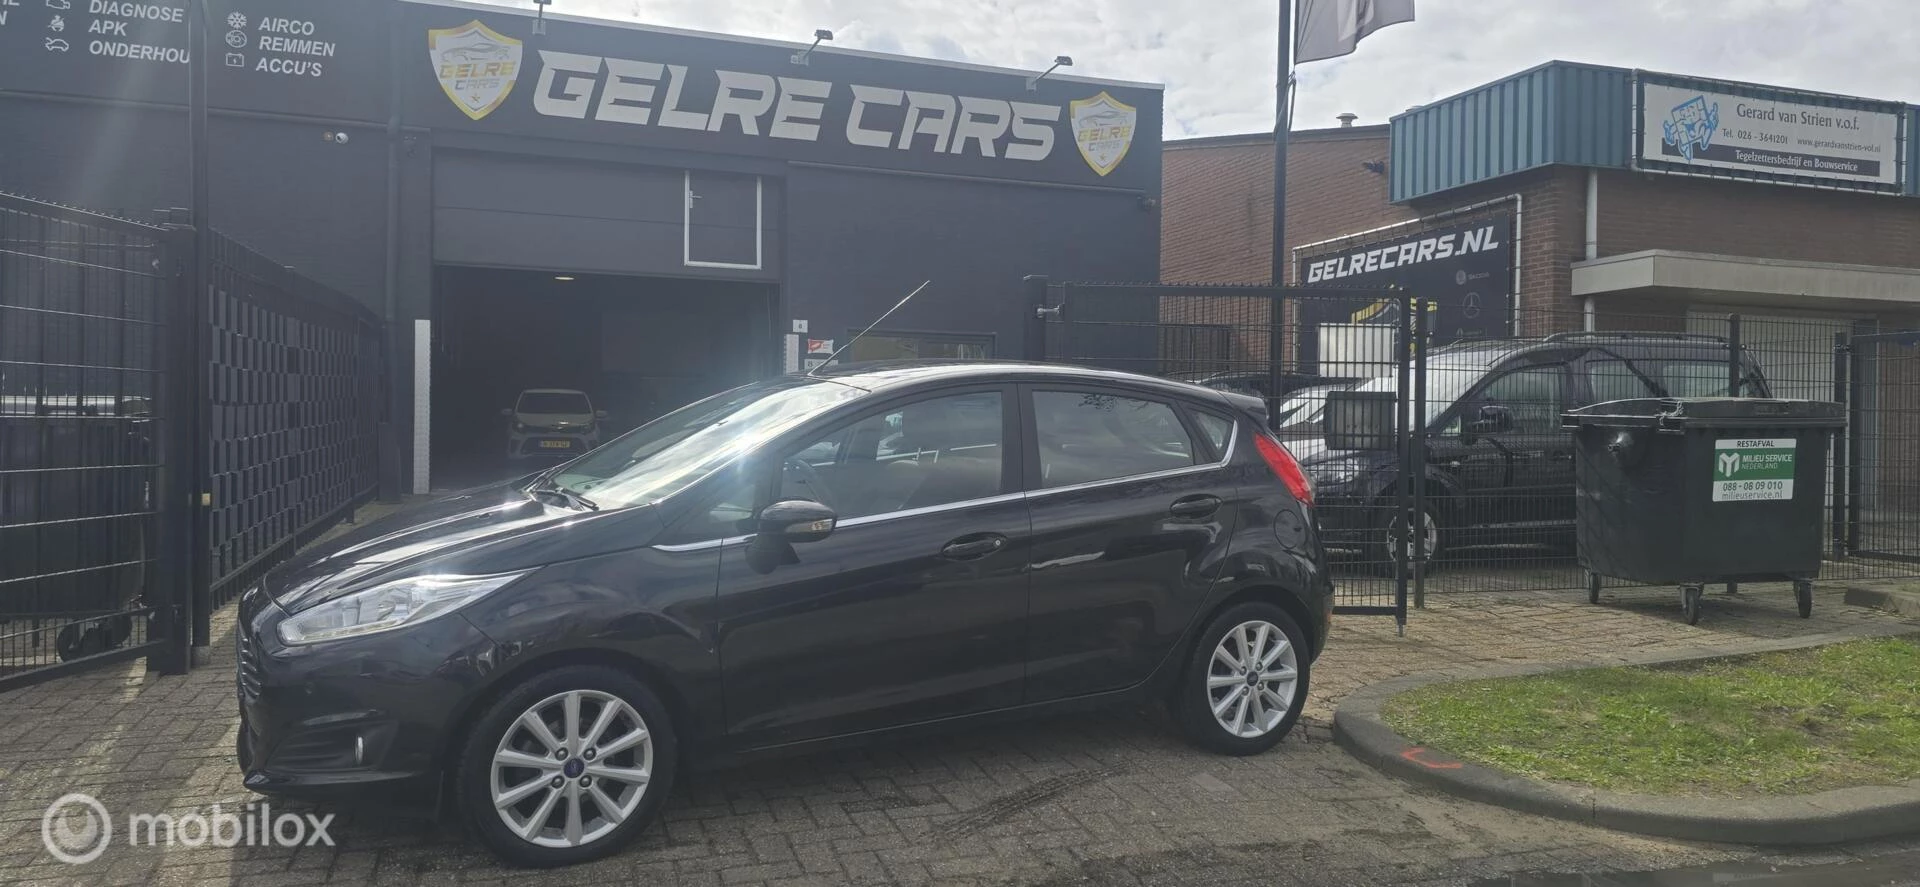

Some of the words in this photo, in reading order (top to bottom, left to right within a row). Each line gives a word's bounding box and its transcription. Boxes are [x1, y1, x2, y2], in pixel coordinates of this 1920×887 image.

[89, 0, 184, 22] DIAGNOSE
[88, 19, 128, 36] APK
[258, 16, 315, 36] AIRCO
[89, 40, 190, 63] ONDERHOU
[259, 35, 336, 57] REMMEN
[256, 57, 322, 77] ACCU'S
[440, 61, 516, 79] GELRE
[455, 79, 501, 90] CARS
[533, 50, 832, 141] GELRE
[846, 84, 1062, 161] CARS
[1736, 103, 1775, 121] Gerard
[1778, 111, 1797, 123] van
[1800, 111, 1832, 128] Strien
[1078, 126, 1131, 142] GELRE
[1722, 128, 1734, 138] Tel.
[1737, 130, 1752, 140] 026
[1735, 149, 1802, 168] Tegelzettersbedrijf
[1803, 158, 1813, 168] en
[1814, 158, 1859, 172] Bouwservice
[1307, 225, 1499, 284] GELRECARS.NL
[1737, 440, 1775, 448] RESTAFVAL
[1741, 462, 1778, 470] NEDERLAND
[1742, 454, 1764, 462] MILIEU
[1765, 454, 1793, 462] SERVICE
[1755, 481, 1766, 490] 09
[1767, 481, 1783, 490] 010
[1722, 490, 1783, 500] milieuservice.nl
